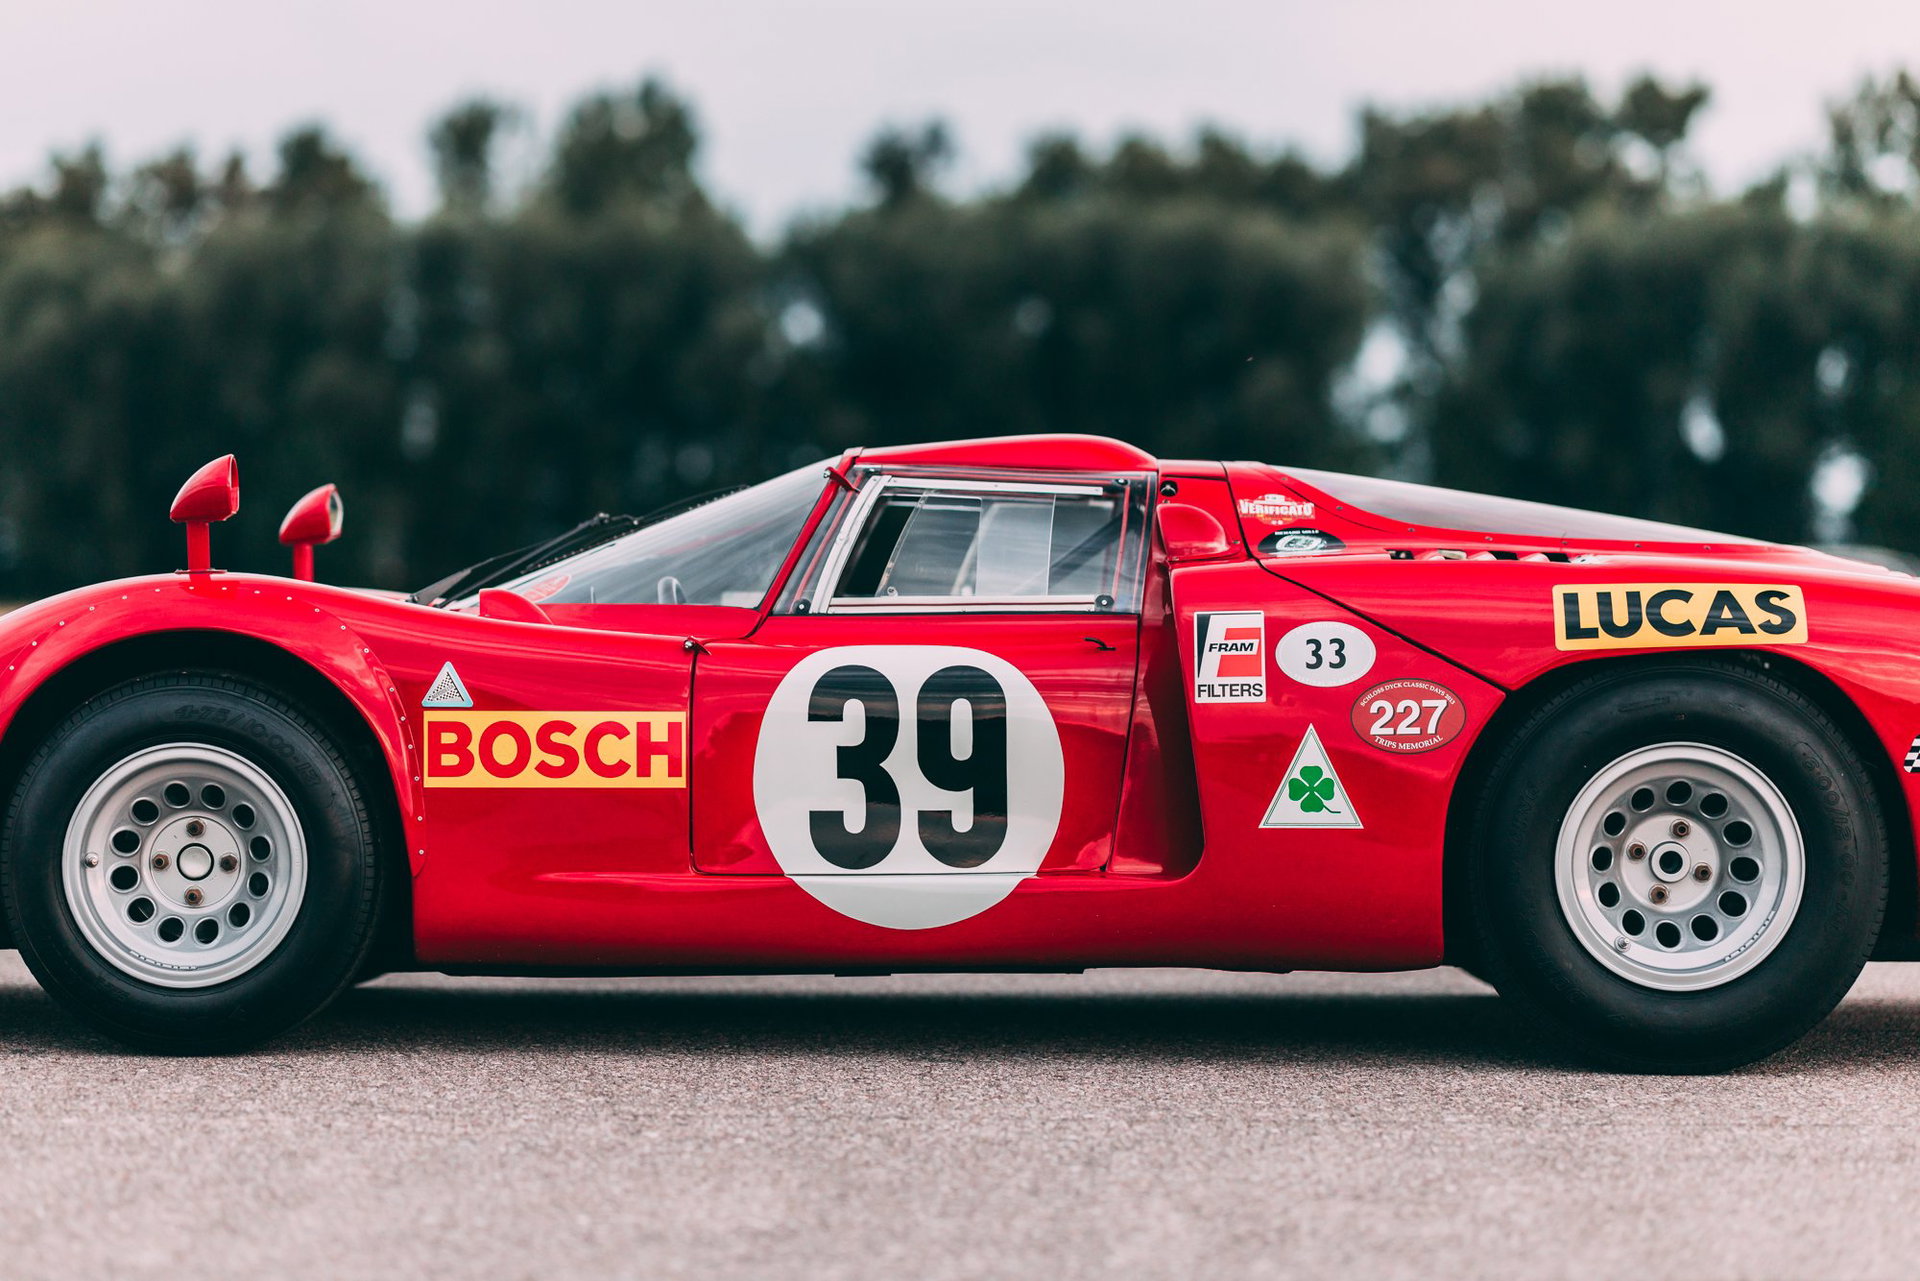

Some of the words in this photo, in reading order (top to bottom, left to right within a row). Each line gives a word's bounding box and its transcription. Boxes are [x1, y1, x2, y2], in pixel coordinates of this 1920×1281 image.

[1562, 589, 1797, 640] LUCAS
[1208, 642, 1254, 653] FRAM
[1305, 637, 1347, 670] 33
[1197, 683, 1263, 698] FILTERS
[1360, 687, 1384, 706] SCHLOSS
[1385, 682, 1403, 691] DYCK
[1403, 681, 1430, 690] CLASSIC
[1430, 686, 1445, 696] DAYS
[1370, 699, 1449, 735] 227
[427, 720, 682, 779] BOSCH
[1374, 736, 1397, 749] TRIPS
[1398, 735, 1443, 750] MEMORIAL
[807, 664, 1008, 869] 39
